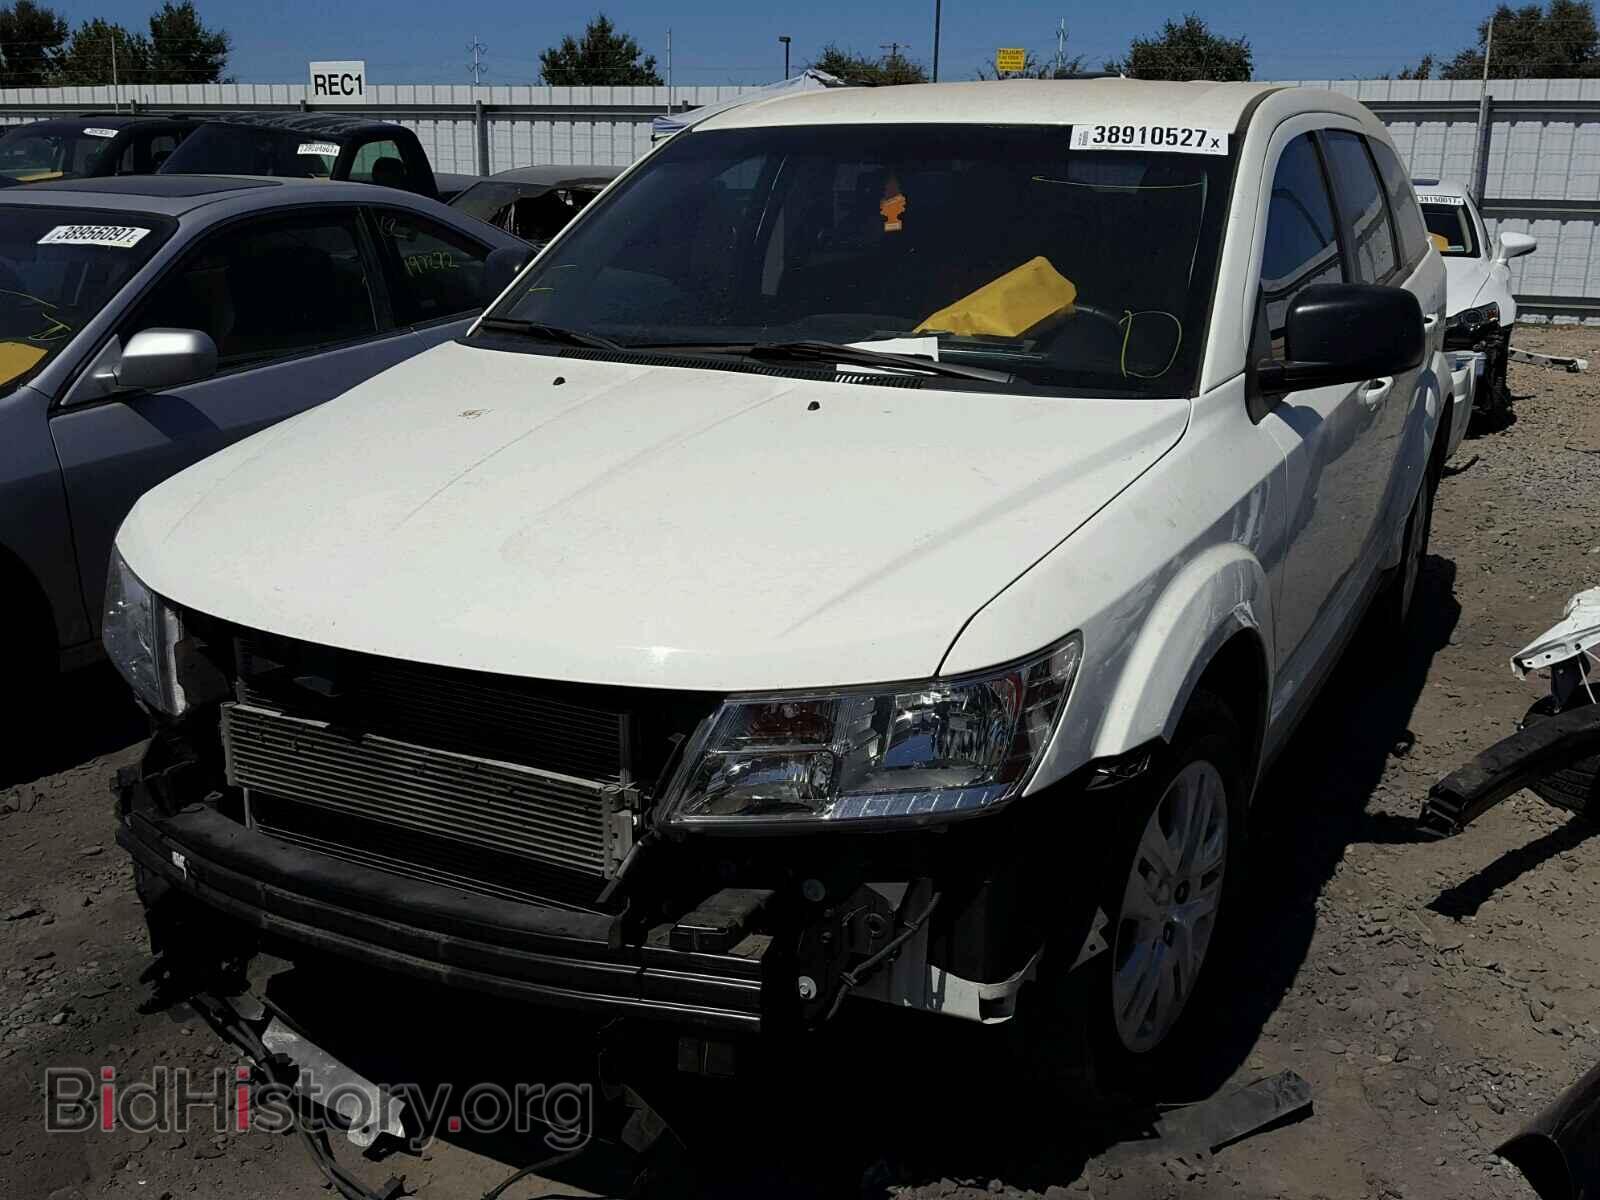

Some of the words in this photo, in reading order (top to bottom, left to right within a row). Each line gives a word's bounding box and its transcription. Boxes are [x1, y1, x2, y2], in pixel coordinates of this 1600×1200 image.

[314, 73, 363, 96] REC1
[1092, 126, 1207, 148] 38910527
[57, 226, 136, 242] 38956097
